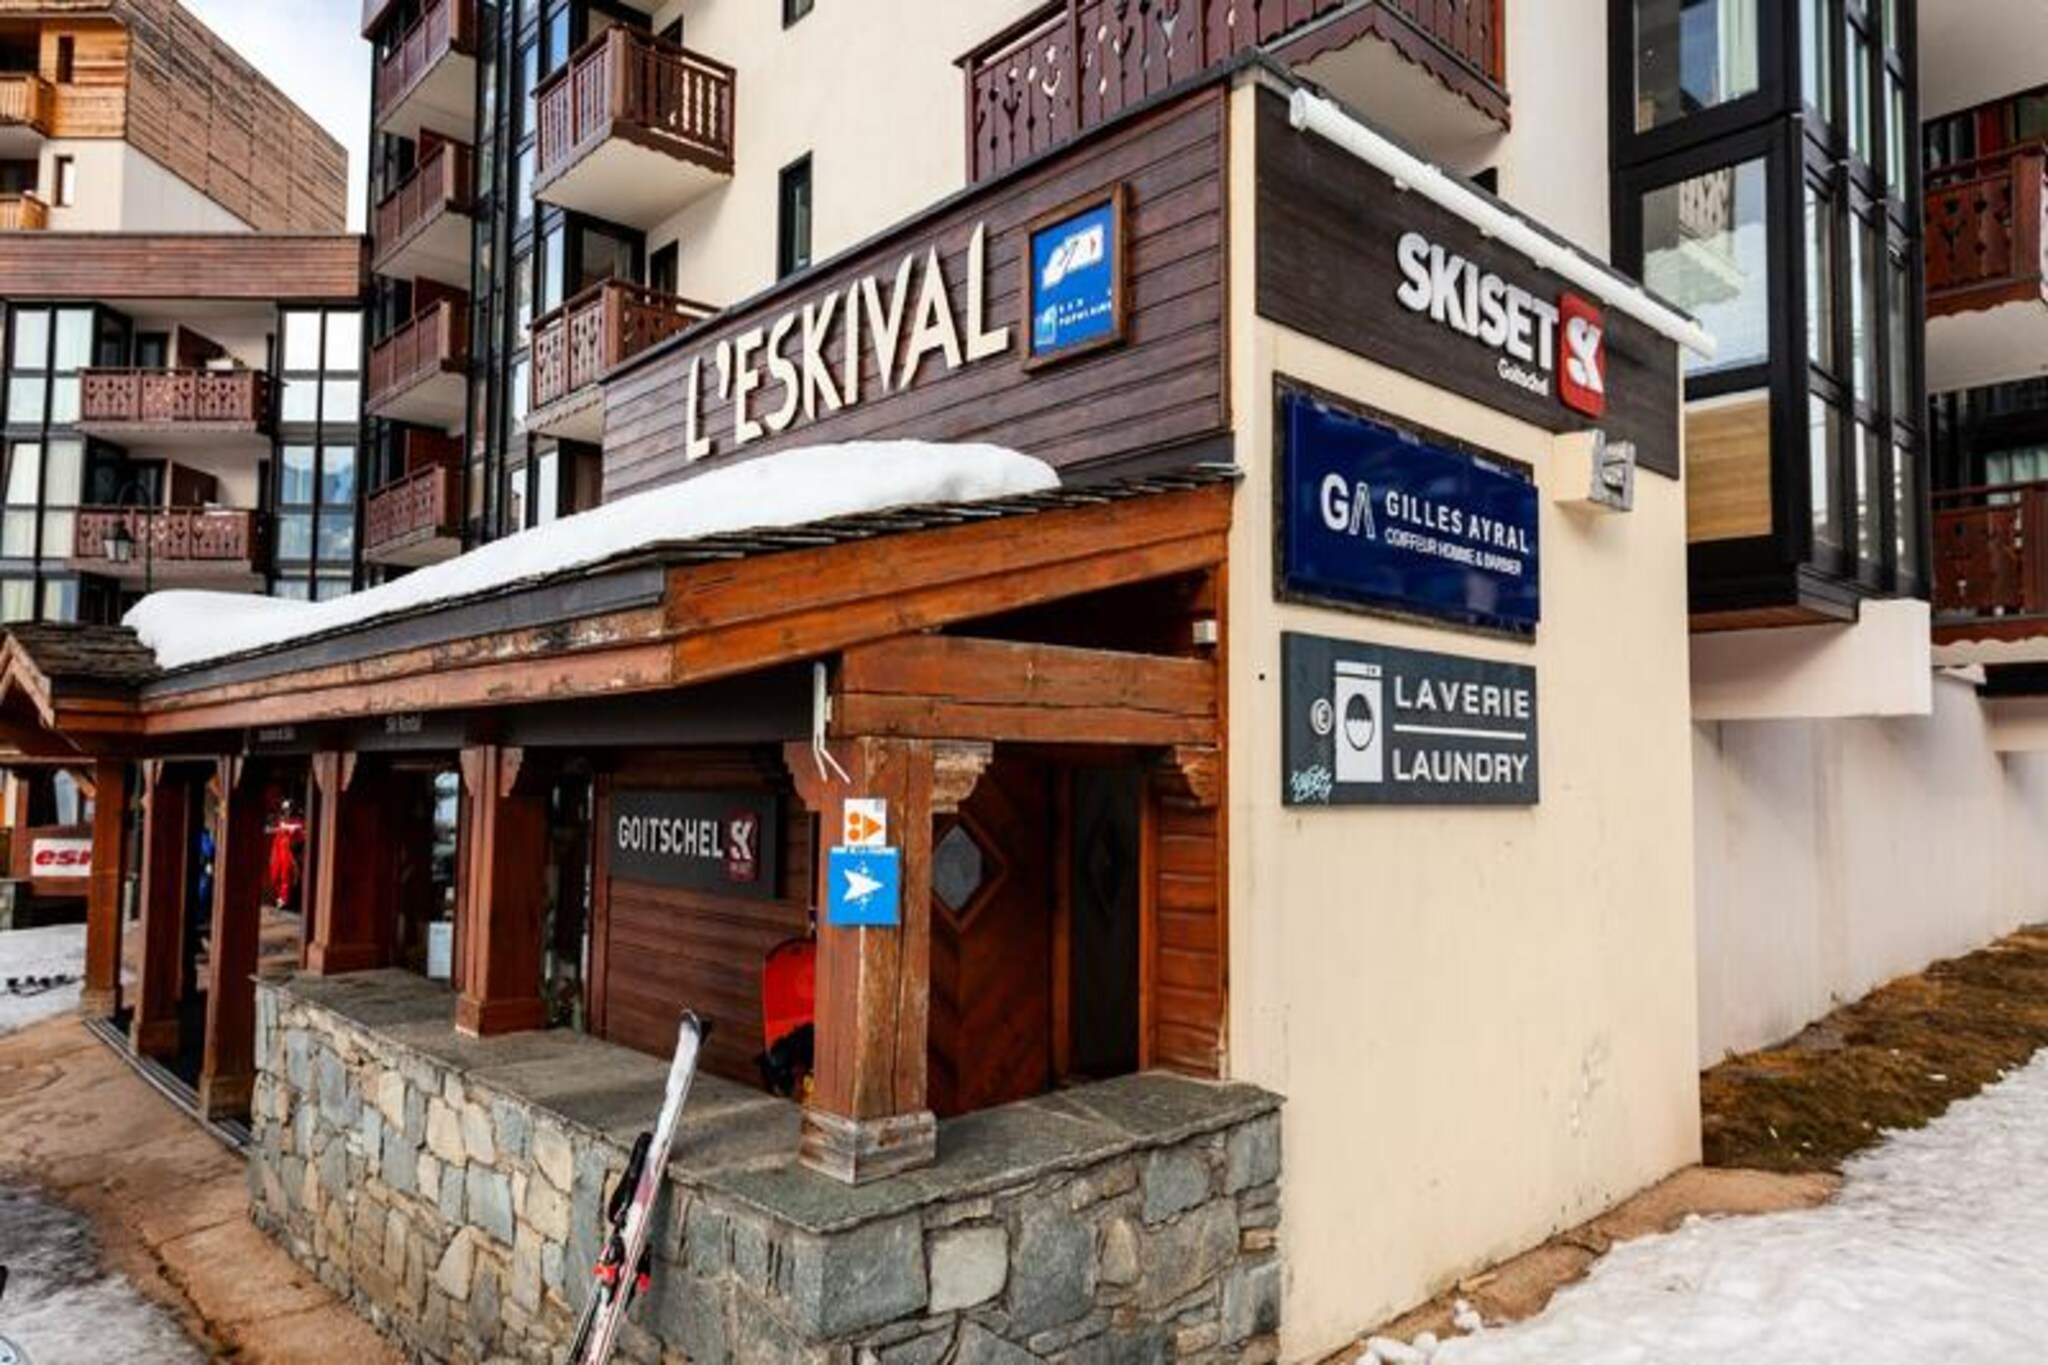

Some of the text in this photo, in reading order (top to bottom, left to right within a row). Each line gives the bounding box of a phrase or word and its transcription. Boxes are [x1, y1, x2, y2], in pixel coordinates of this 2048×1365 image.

[1397, 231, 1559, 371] SKISET
[686, 221, 1008, 461] L'ESKIVAL
[1385, 490, 1529, 554] GILLES AYRAL
[1394, 675, 1529, 719] LAVERIE
[1393, 749, 1529, 783] LAUNDRY
[618, 815, 723, 858] GOITSCHEL
